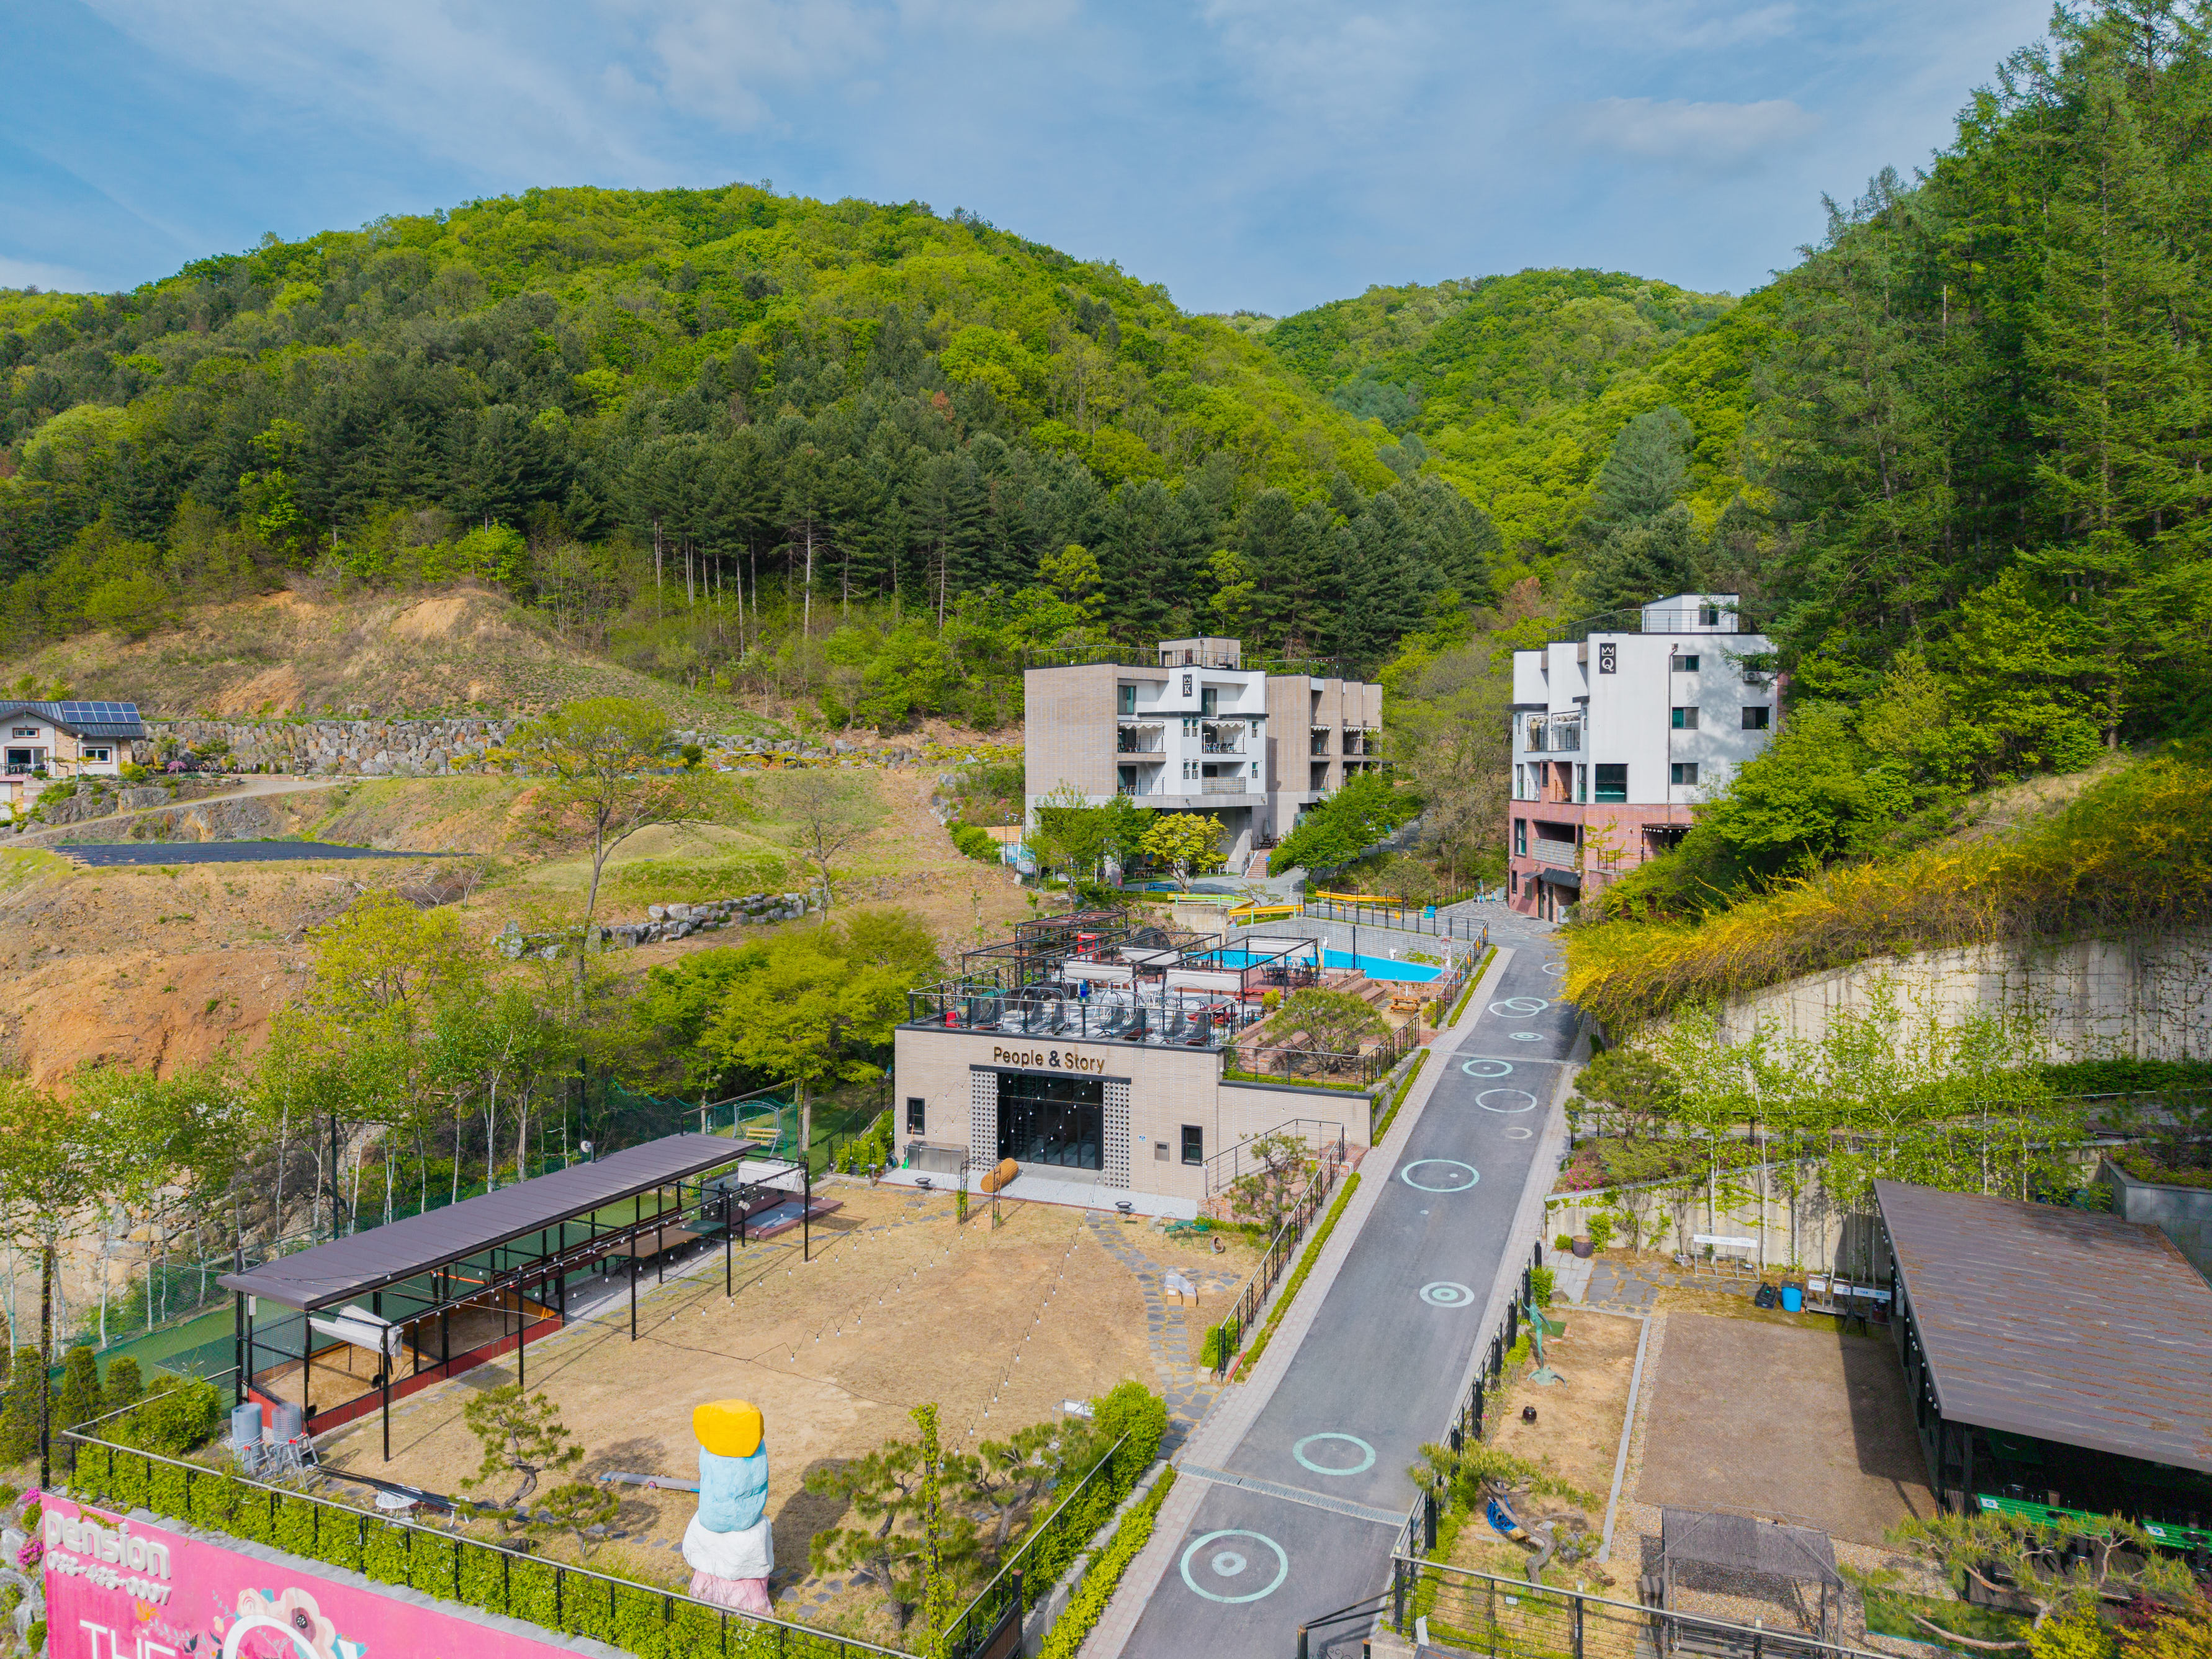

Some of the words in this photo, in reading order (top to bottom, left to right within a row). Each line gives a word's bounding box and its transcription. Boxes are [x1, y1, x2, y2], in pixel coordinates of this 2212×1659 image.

[1601, 657, 1614, 672] Q
[1184, 685, 1191, 694] K
[994, 1046, 1043, 1066] People
[1048, 1050, 1061, 1068] &
[1064, 1052, 1105, 1074] Story
[45, 1509, 171, 1580] pension
